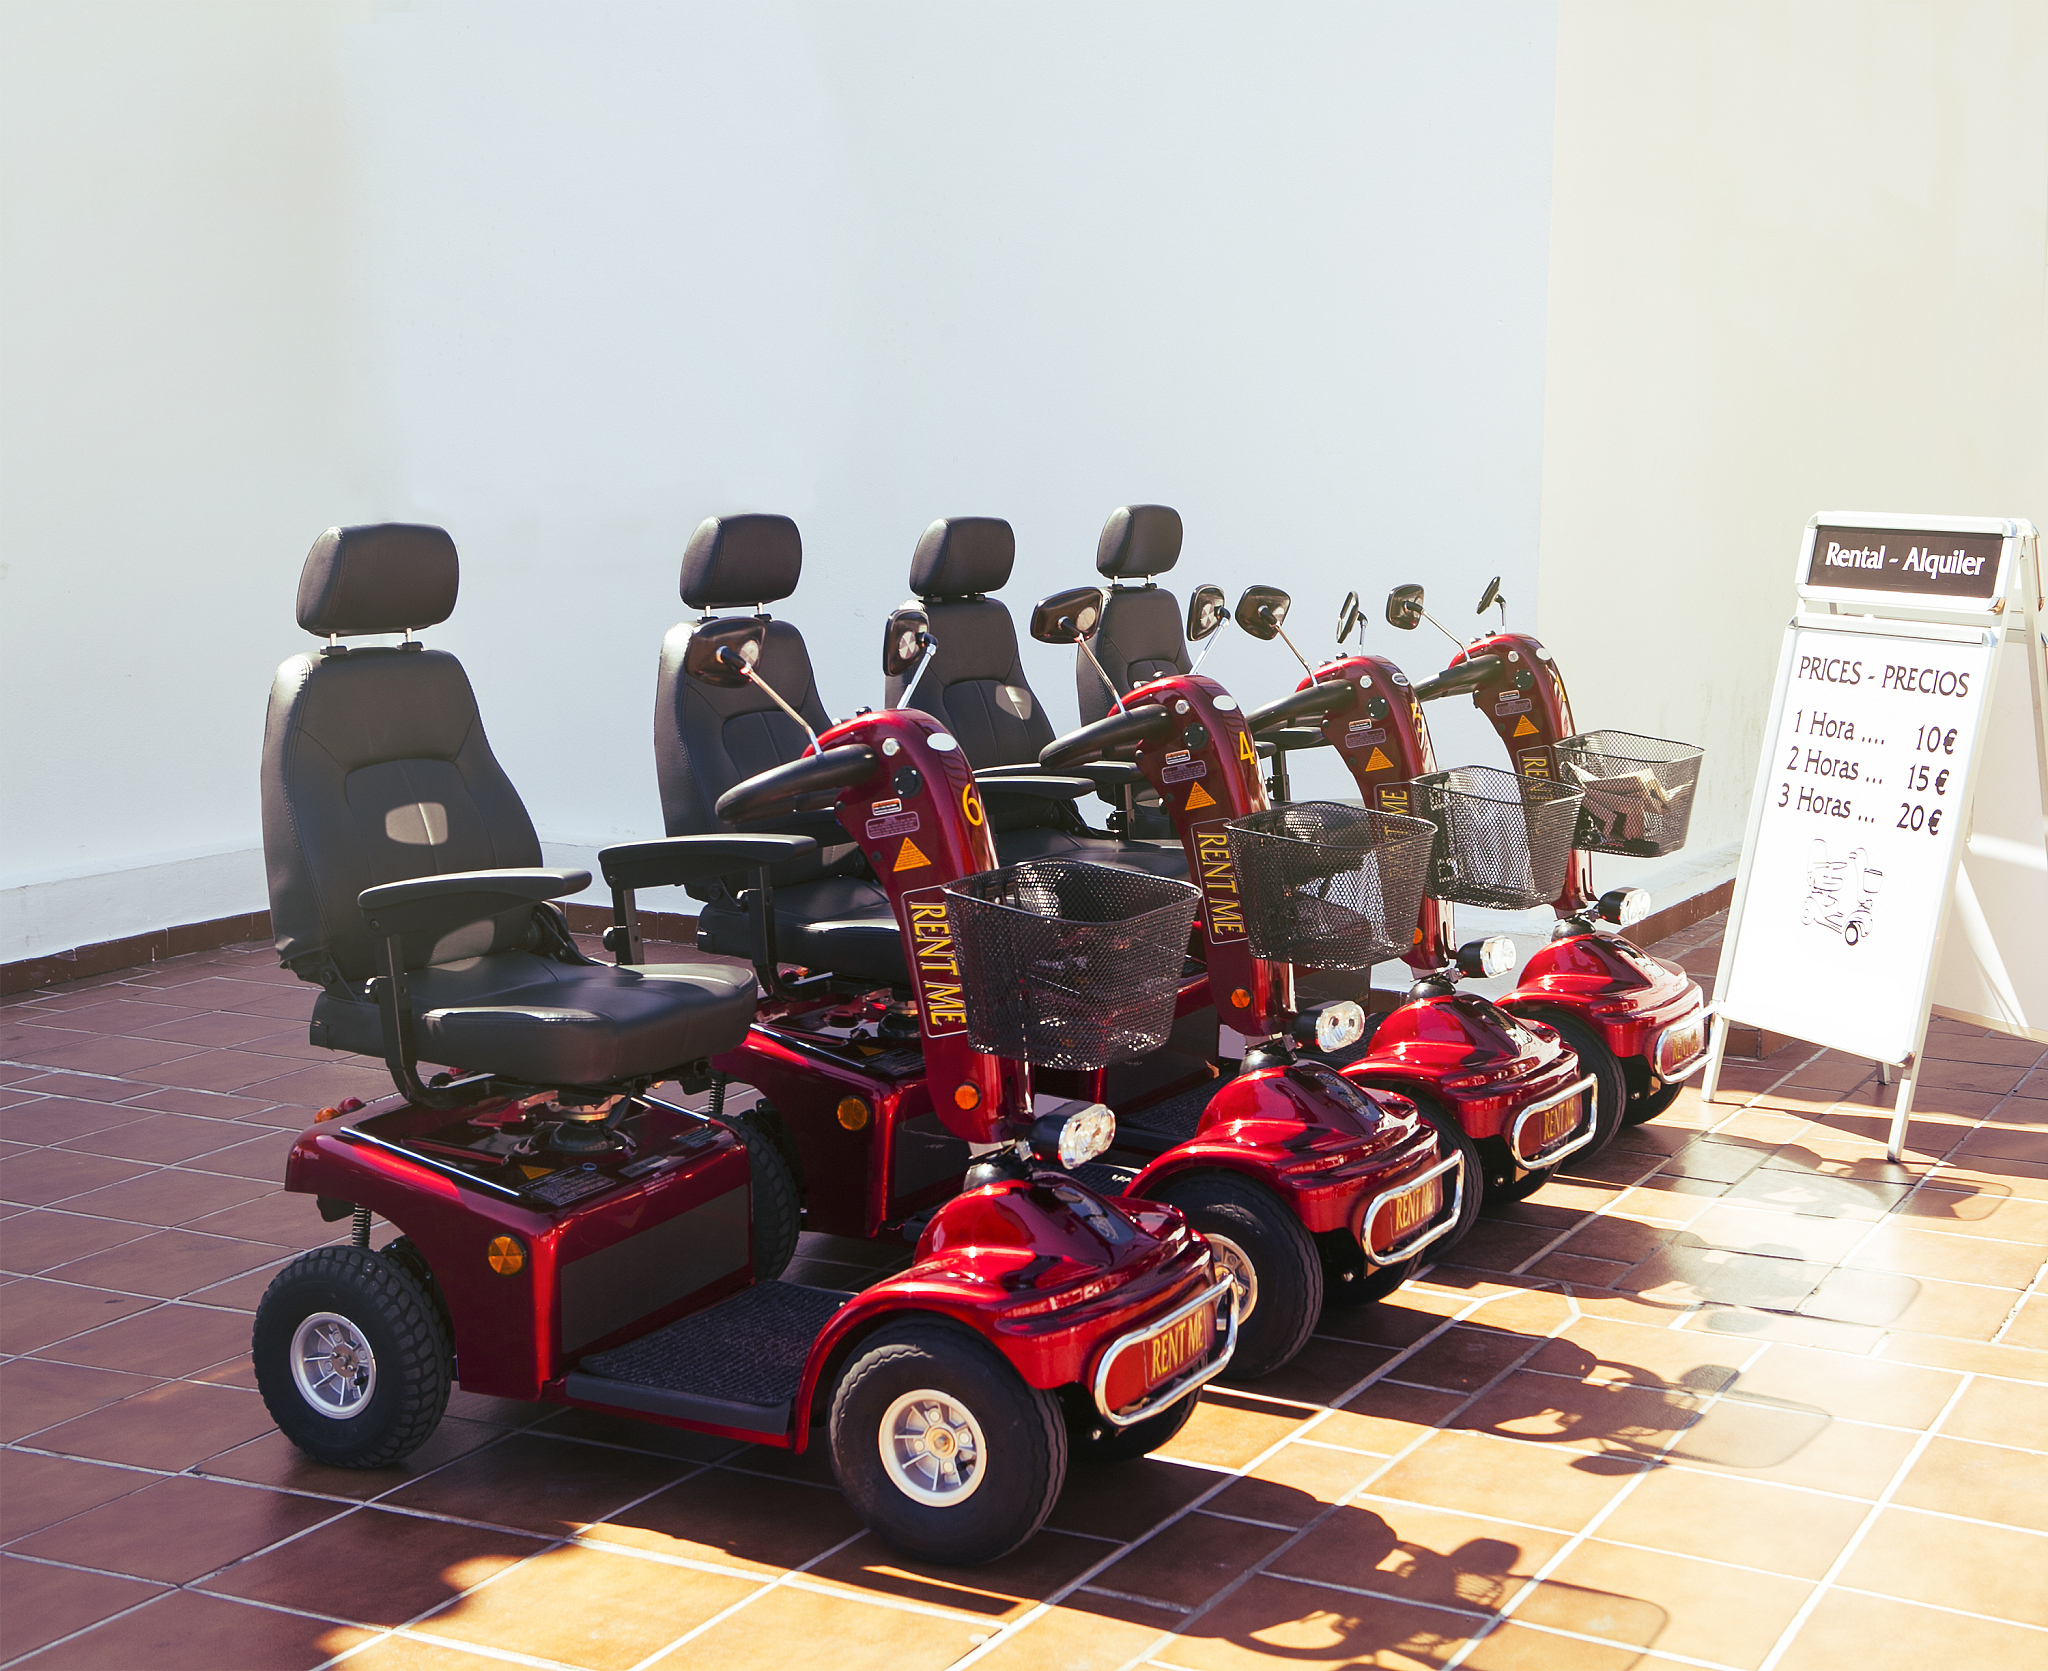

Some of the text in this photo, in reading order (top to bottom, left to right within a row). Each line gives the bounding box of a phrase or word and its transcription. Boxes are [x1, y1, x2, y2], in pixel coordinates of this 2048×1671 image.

[1825, 542, 1885, 570] Rental
[1902, 547, 1986, 580] Alquiler
[1798, 655, 1863, 686] PRICES
[1881, 664, 1970, 698] PRECIOS
[1794, 709, 1803, 733] 1
[1809, 710, 1855, 741] Hora
[1238, 731, 1255, 765] 4
[1787, 746, 1799, 771] 2
[1804, 748, 1859, 781] Horas
[962, 783, 983, 827] 6
[1778, 783, 1790, 808] 3
[1797, 786, 1852, 819] Horas
[1196, 831, 1238, 895] RENT
[1209, 897, 1246, 935] ME
[908, 902, 961, 977] RENT
[923, 980, 968, 1028] ME
[1543, 1101, 1565, 1140] RENT
[1395, 1188, 1421, 1232] RENT
[1151, 1311, 1204, 1380] RENT ME
